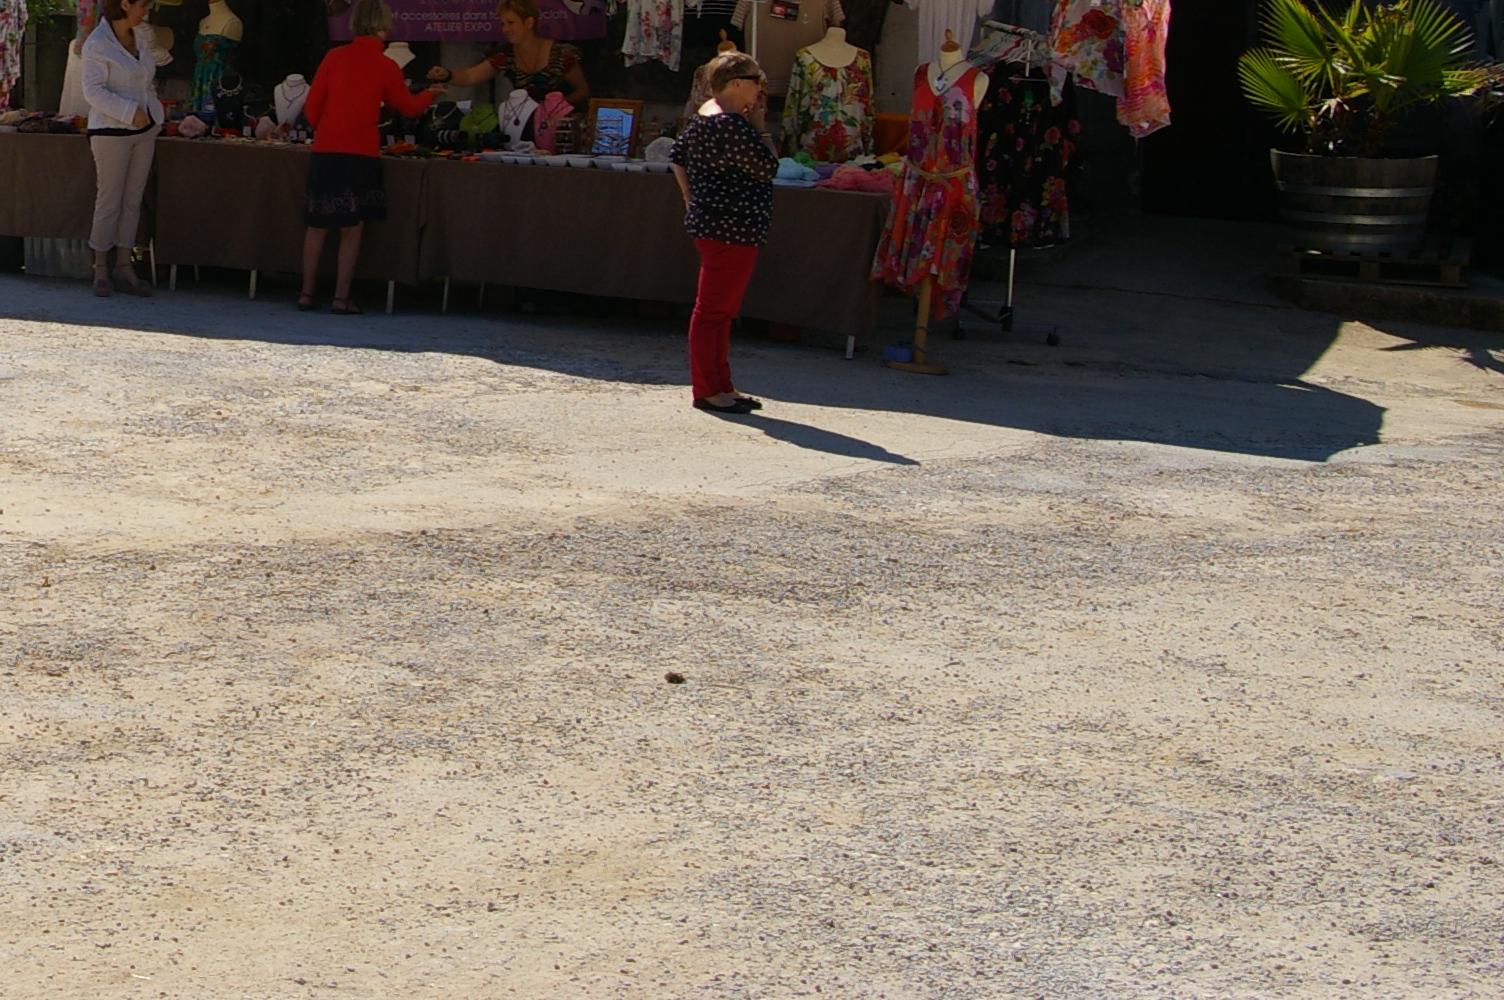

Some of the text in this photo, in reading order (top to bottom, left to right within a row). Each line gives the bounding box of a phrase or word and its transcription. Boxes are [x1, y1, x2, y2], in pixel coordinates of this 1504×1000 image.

[400, 11, 461, 21] accessoires
[462, 10, 488, 21] dans
[424, 21, 492, 32] ATELIER EXPO
